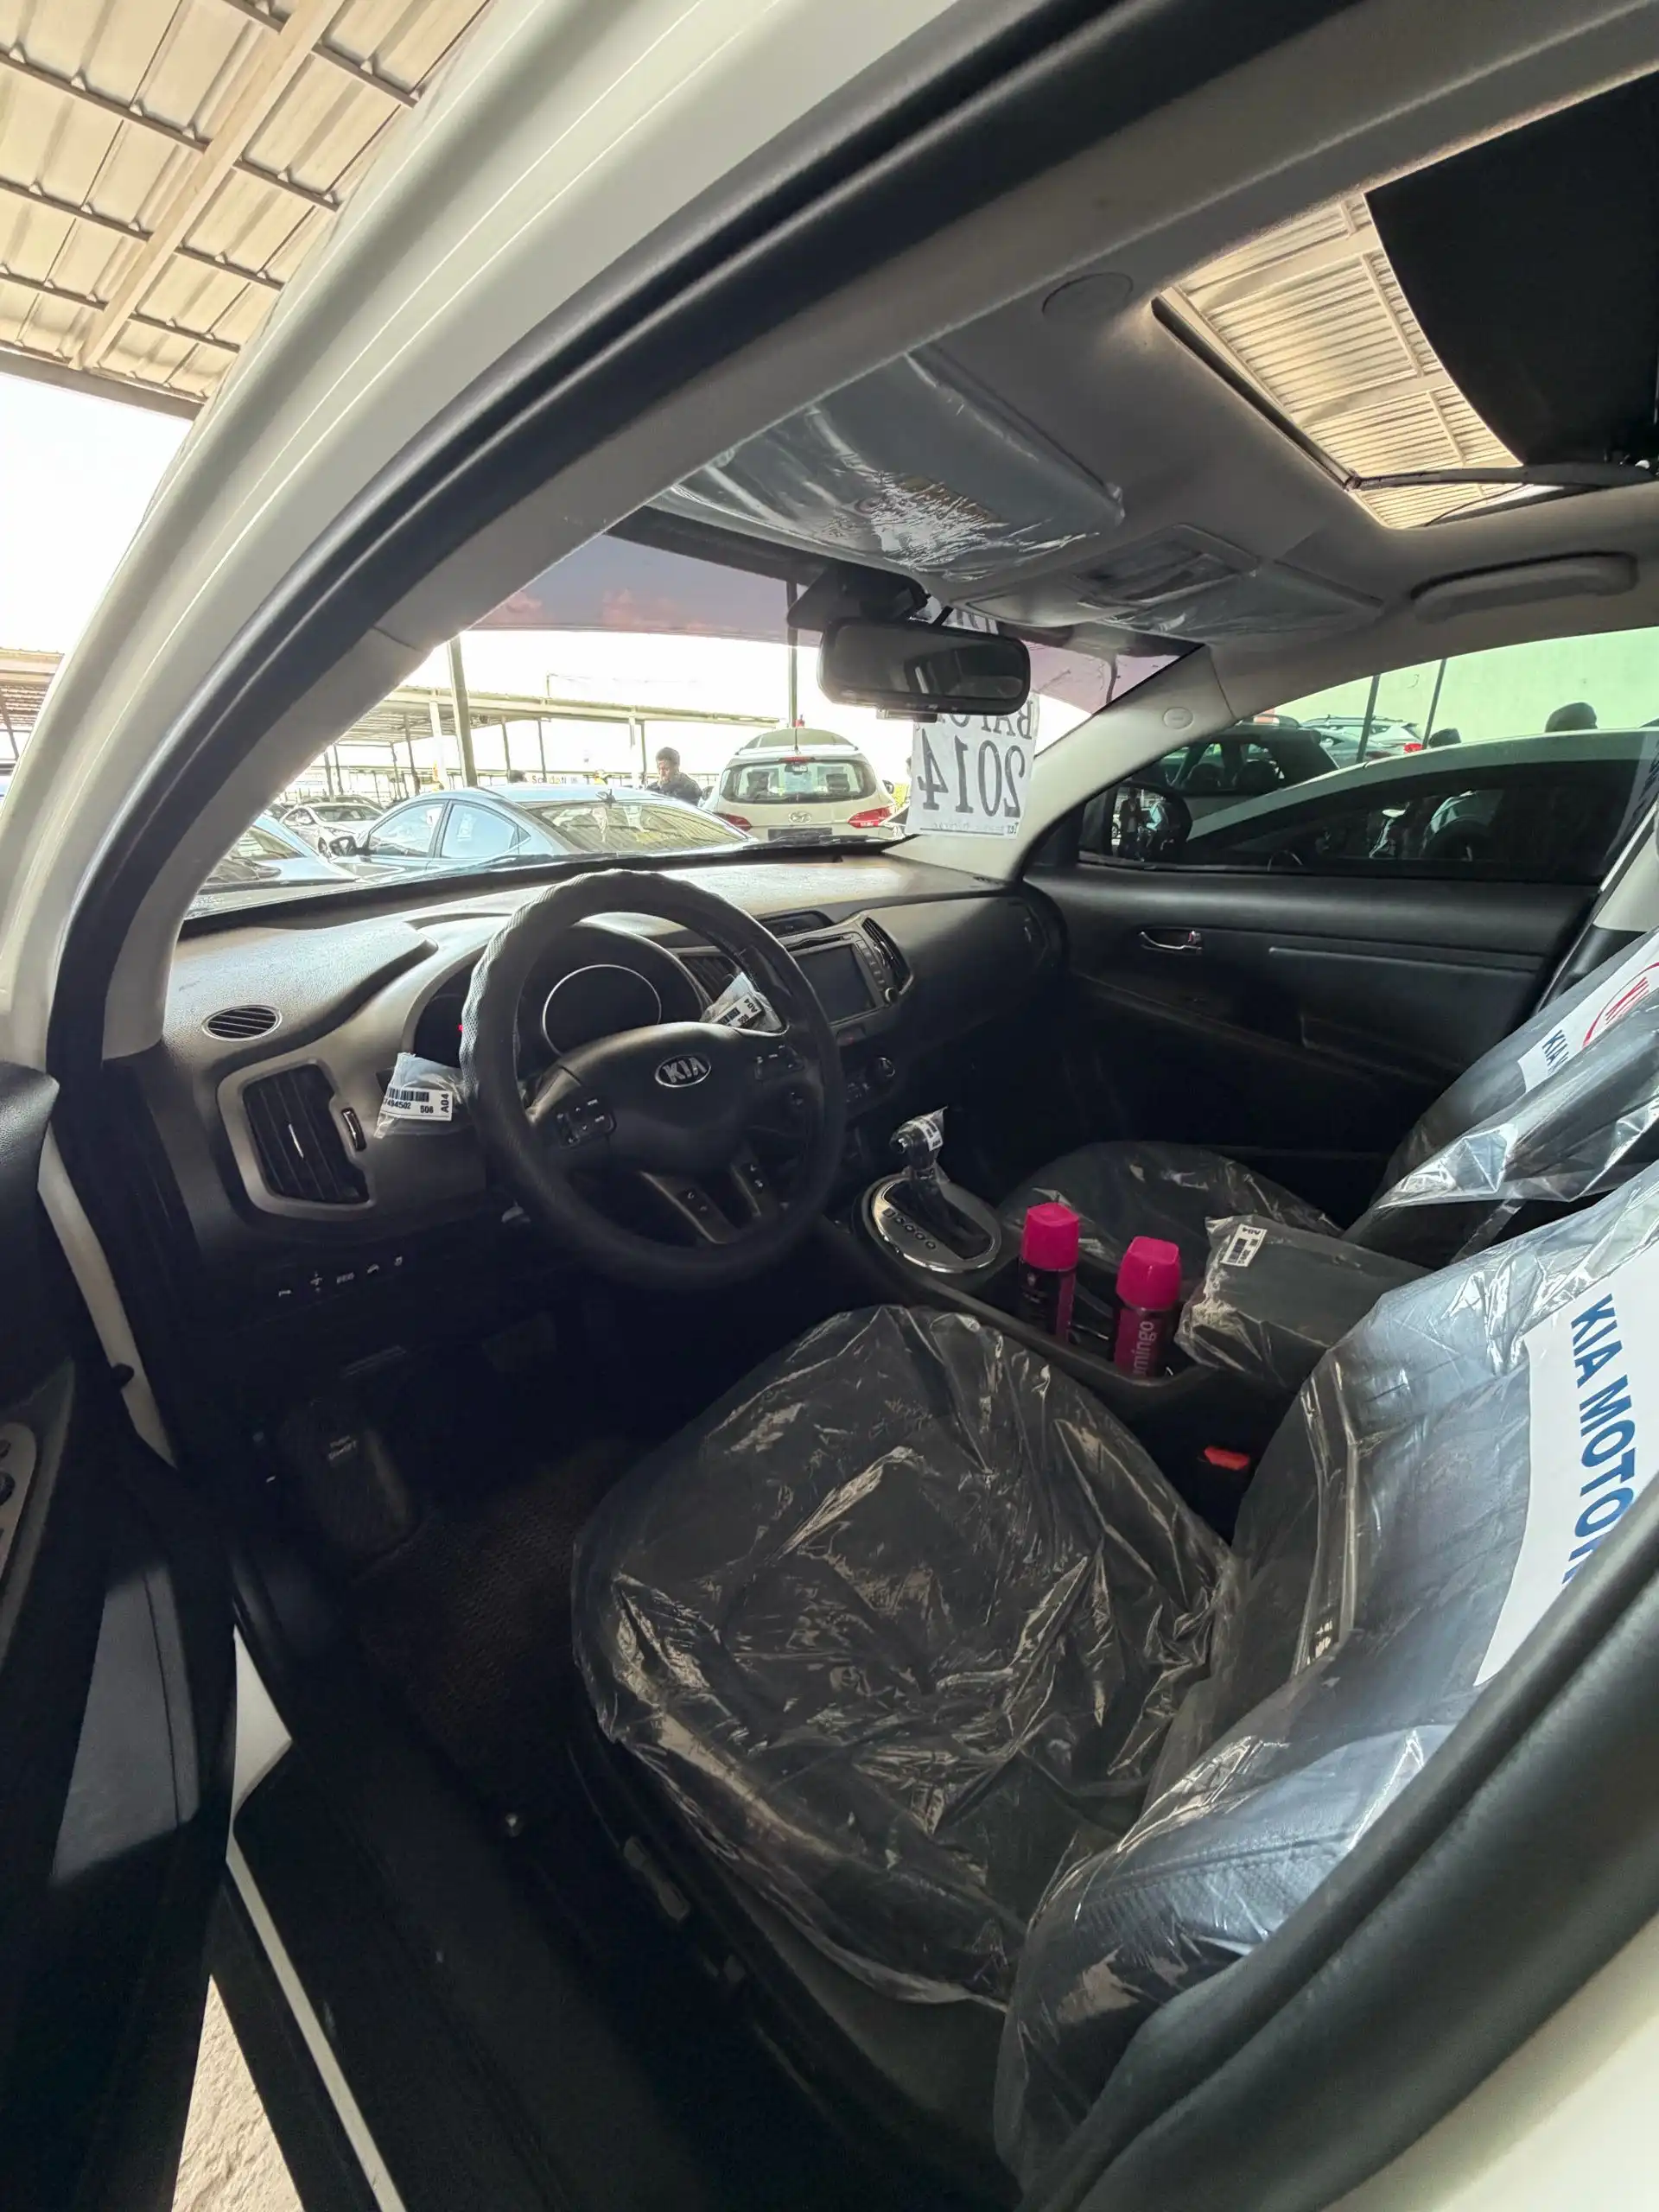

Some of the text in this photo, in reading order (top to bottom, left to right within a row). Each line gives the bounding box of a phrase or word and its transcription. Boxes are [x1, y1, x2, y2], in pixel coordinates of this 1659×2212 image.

[662, 1057, 707, 1084] KIA
[441, 1093, 449, 1113] A04
[1133, 1321, 1157, 1376] mingo
[1571, 1293, 1623, 1389] KIA
